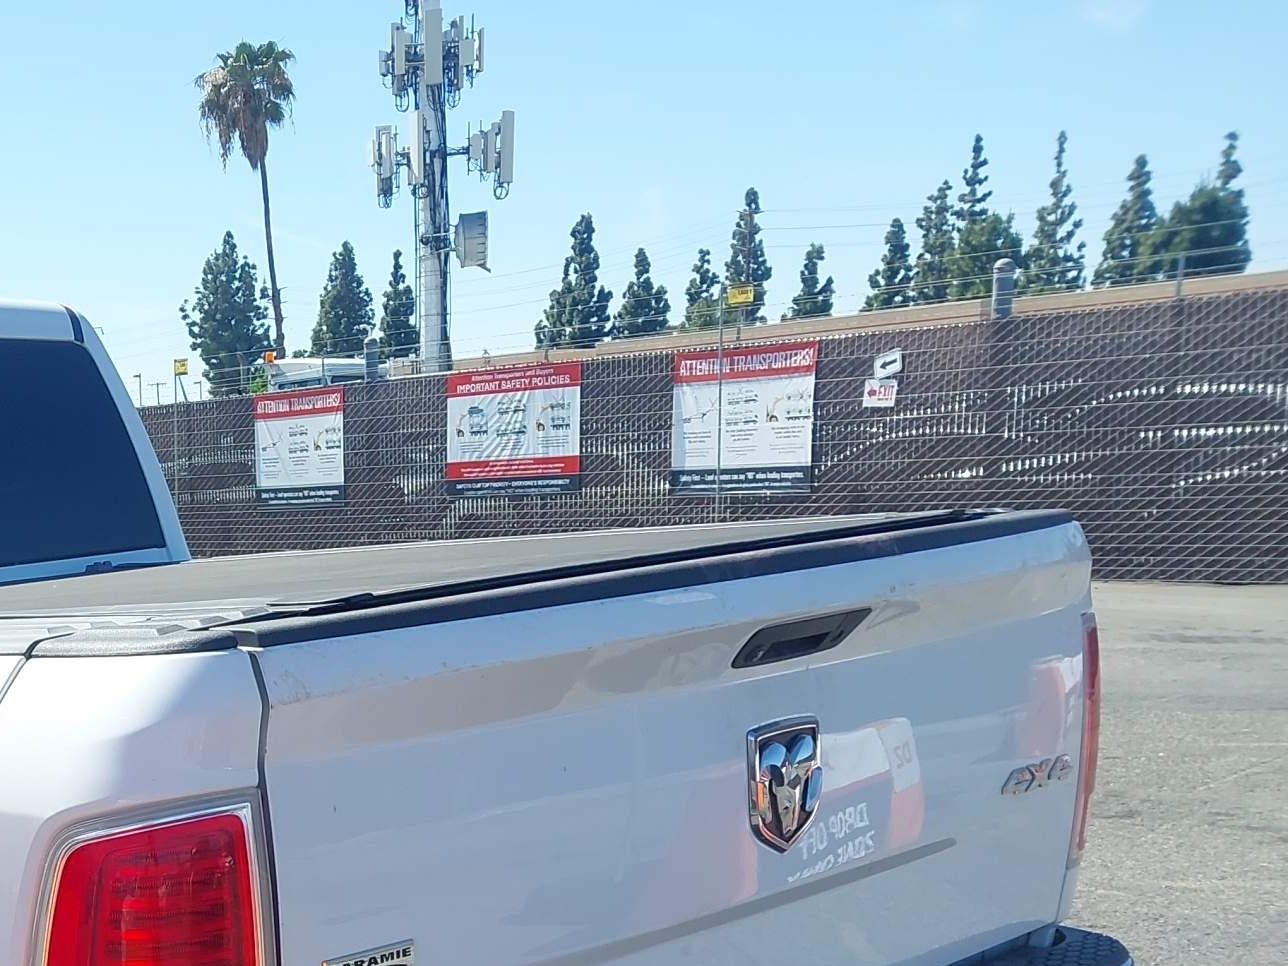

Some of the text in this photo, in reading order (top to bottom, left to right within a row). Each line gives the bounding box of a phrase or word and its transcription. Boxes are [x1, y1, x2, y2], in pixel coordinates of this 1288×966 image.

[679, 348, 814, 376] ATTENTIN TRANSPORTERS!
[456, 375, 570, 393] IMPORTANT SAFETY POLICIES
[878, 384, 895, 400] EXIT
